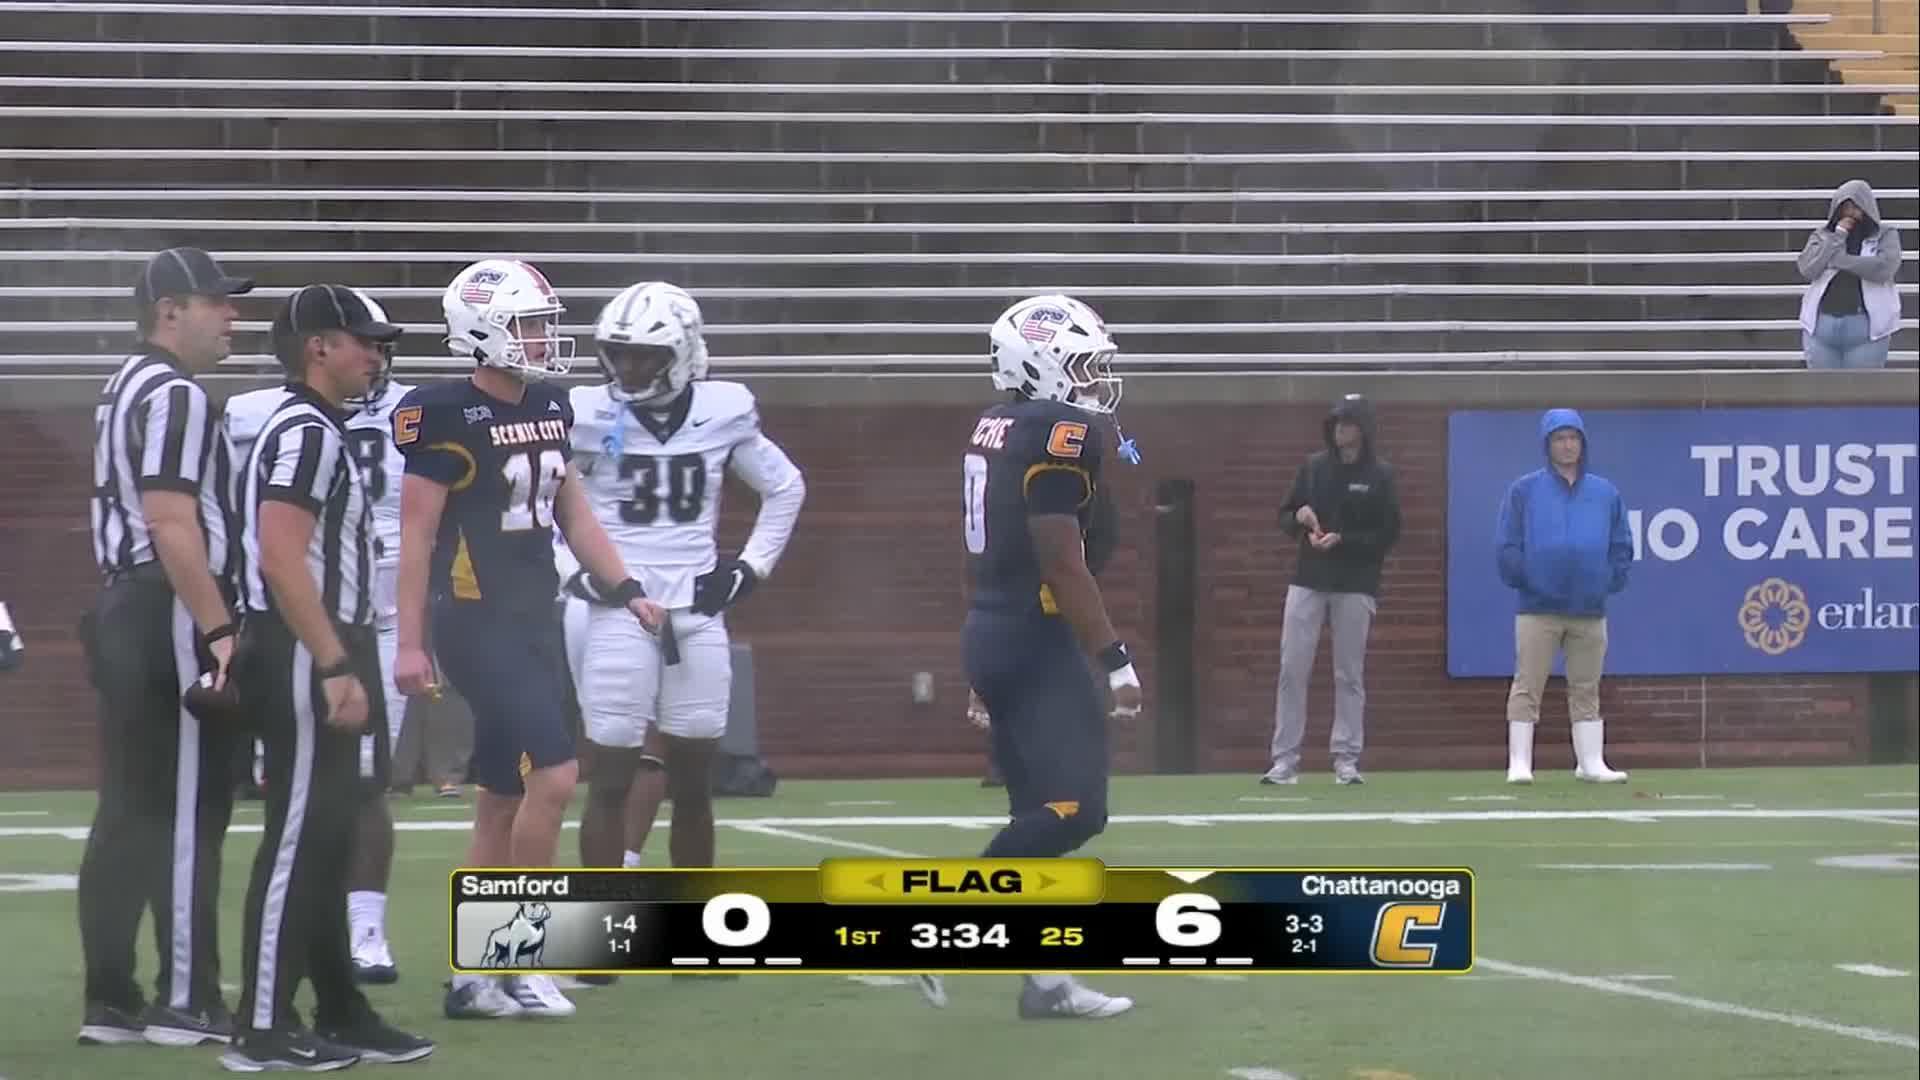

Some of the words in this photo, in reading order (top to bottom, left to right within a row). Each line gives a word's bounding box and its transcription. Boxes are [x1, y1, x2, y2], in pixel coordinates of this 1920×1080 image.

[490, 424, 540, 446] SCENIC
[538, 420, 566, 440] CITY
[617, 453, 706, 525] 30
[1690, 443, 1918, 497] TRUST
[1722, 506, 1914, 560] CARE
